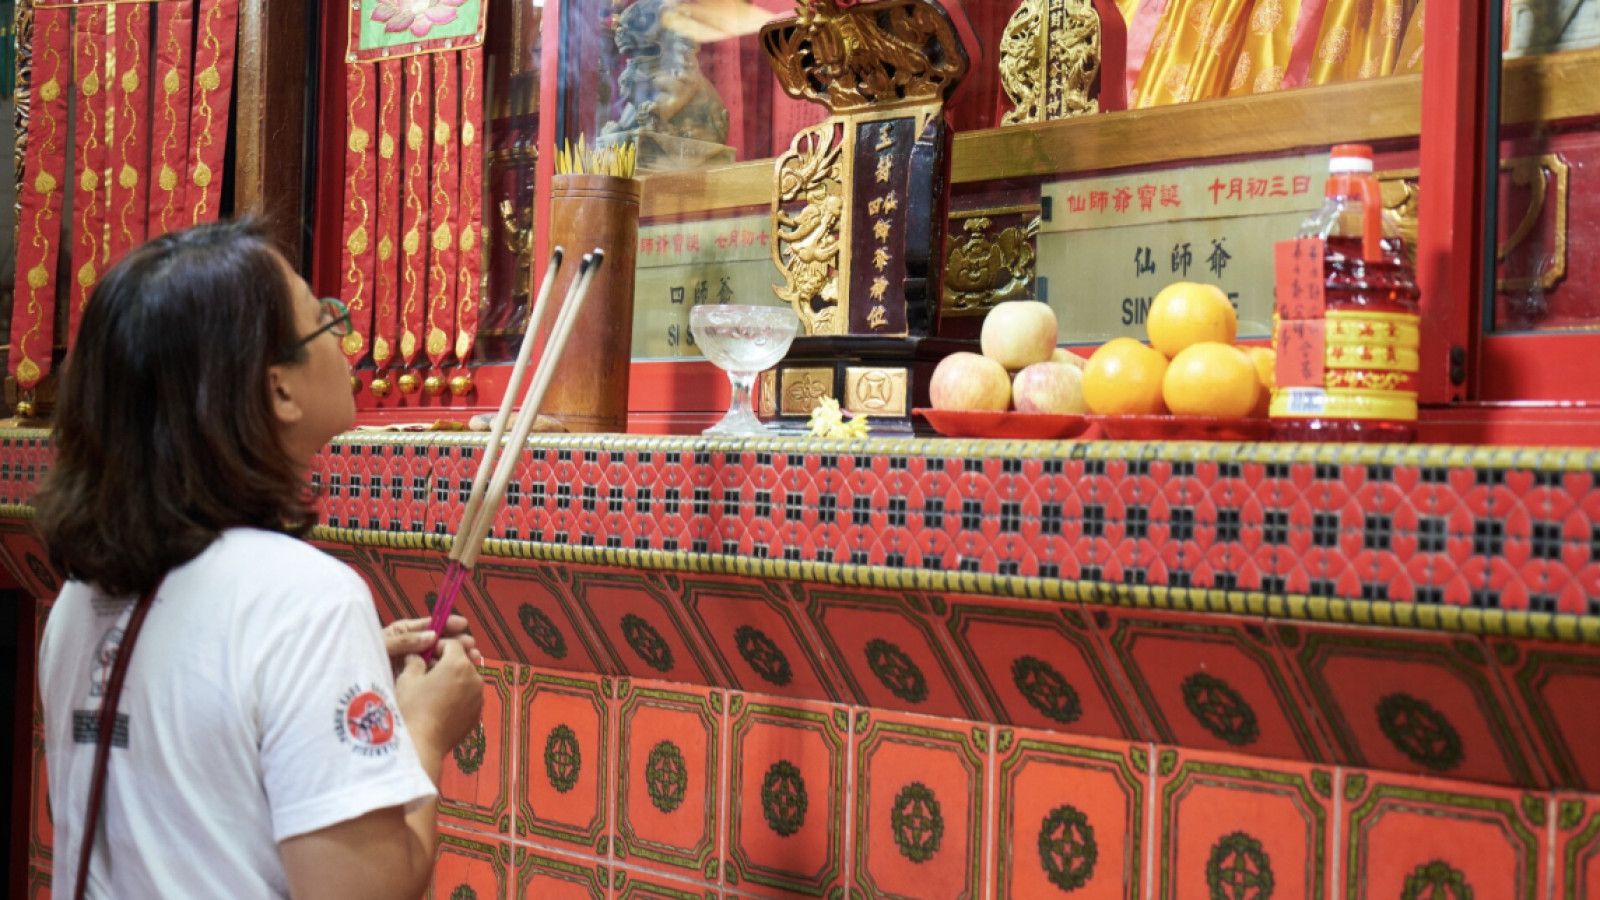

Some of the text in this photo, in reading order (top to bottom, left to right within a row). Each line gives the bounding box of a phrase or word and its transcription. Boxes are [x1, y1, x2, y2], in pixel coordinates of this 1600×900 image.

[1067, 175, 1311, 214] 仙師爺寶誕 十月初三日
[1134, 237, 1232, 278] 仙師爺
